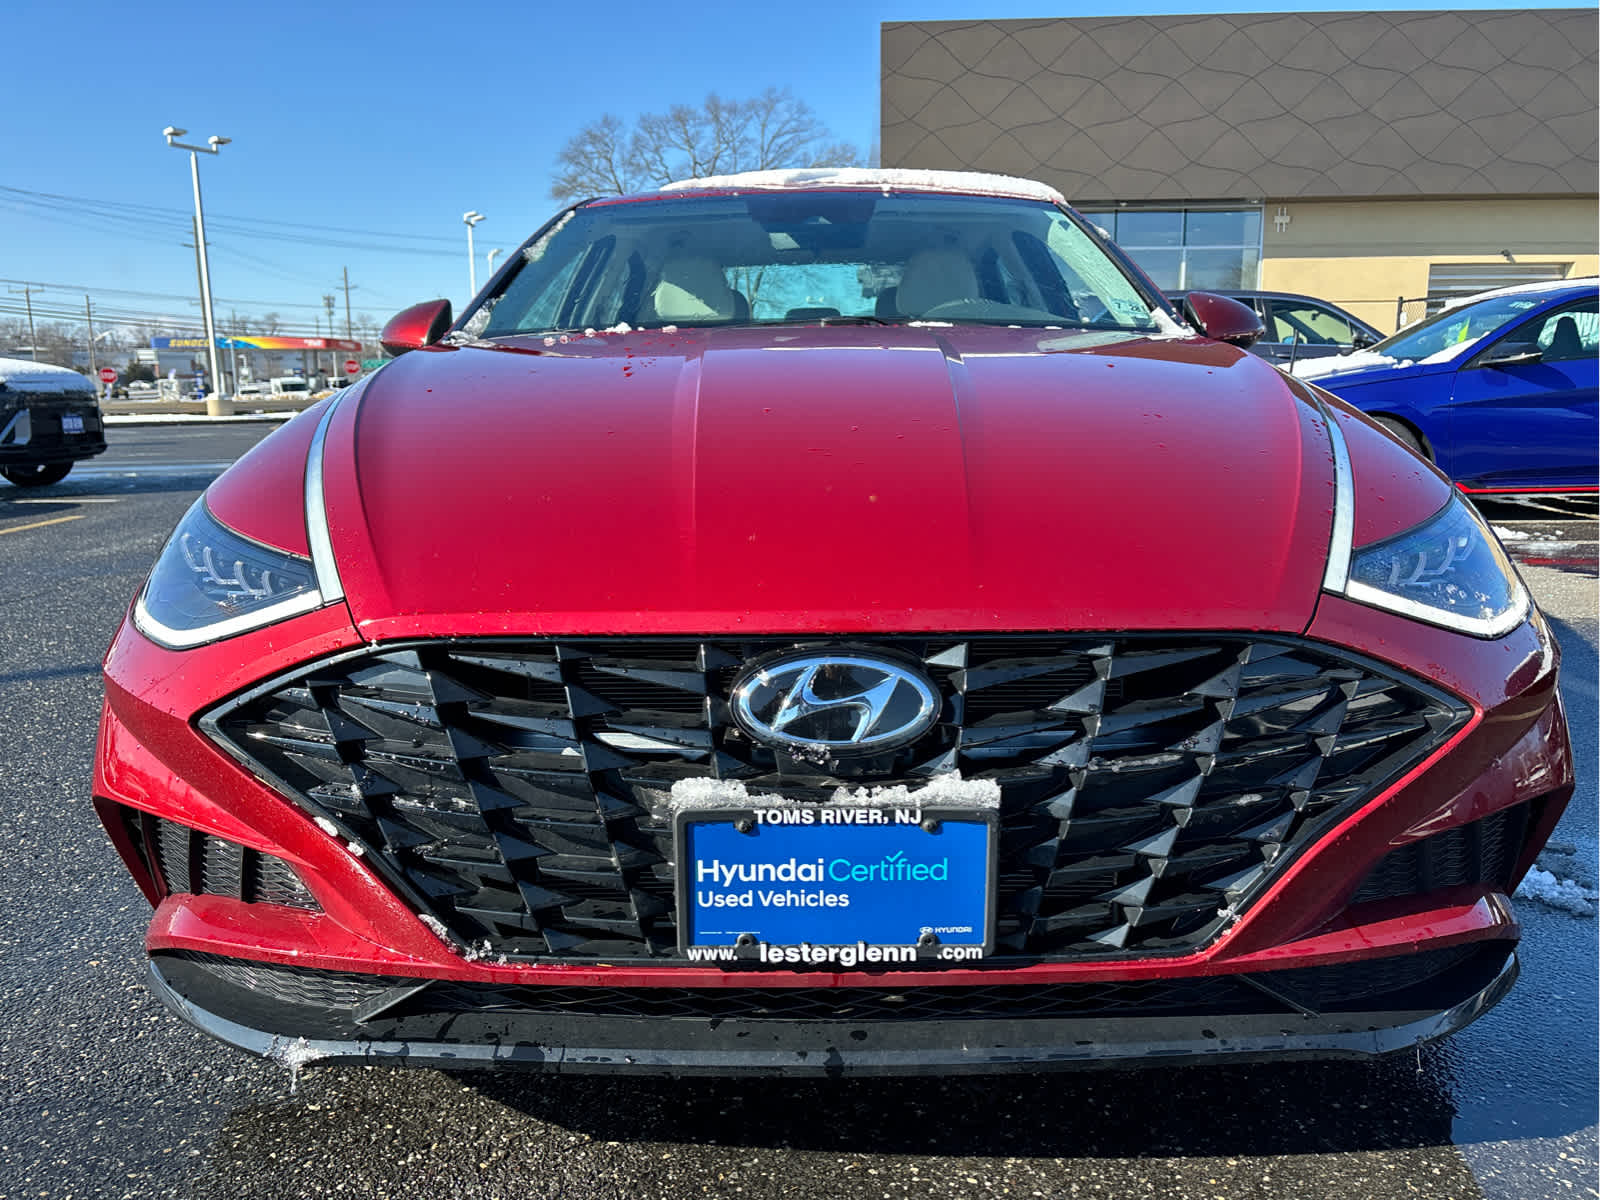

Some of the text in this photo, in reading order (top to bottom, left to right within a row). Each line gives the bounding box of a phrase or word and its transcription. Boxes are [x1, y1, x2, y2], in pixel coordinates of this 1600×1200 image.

[753, 809, 922, 825] TOMS RIVER, NJ
[697, 850, 949, 888] Hyundai Certified
[697, 890, 850, 908] Used Vehicles
[934, 926, 973, 934] HYUNDAI
[686, 942, 984, 967] www. lesterglenn .com
